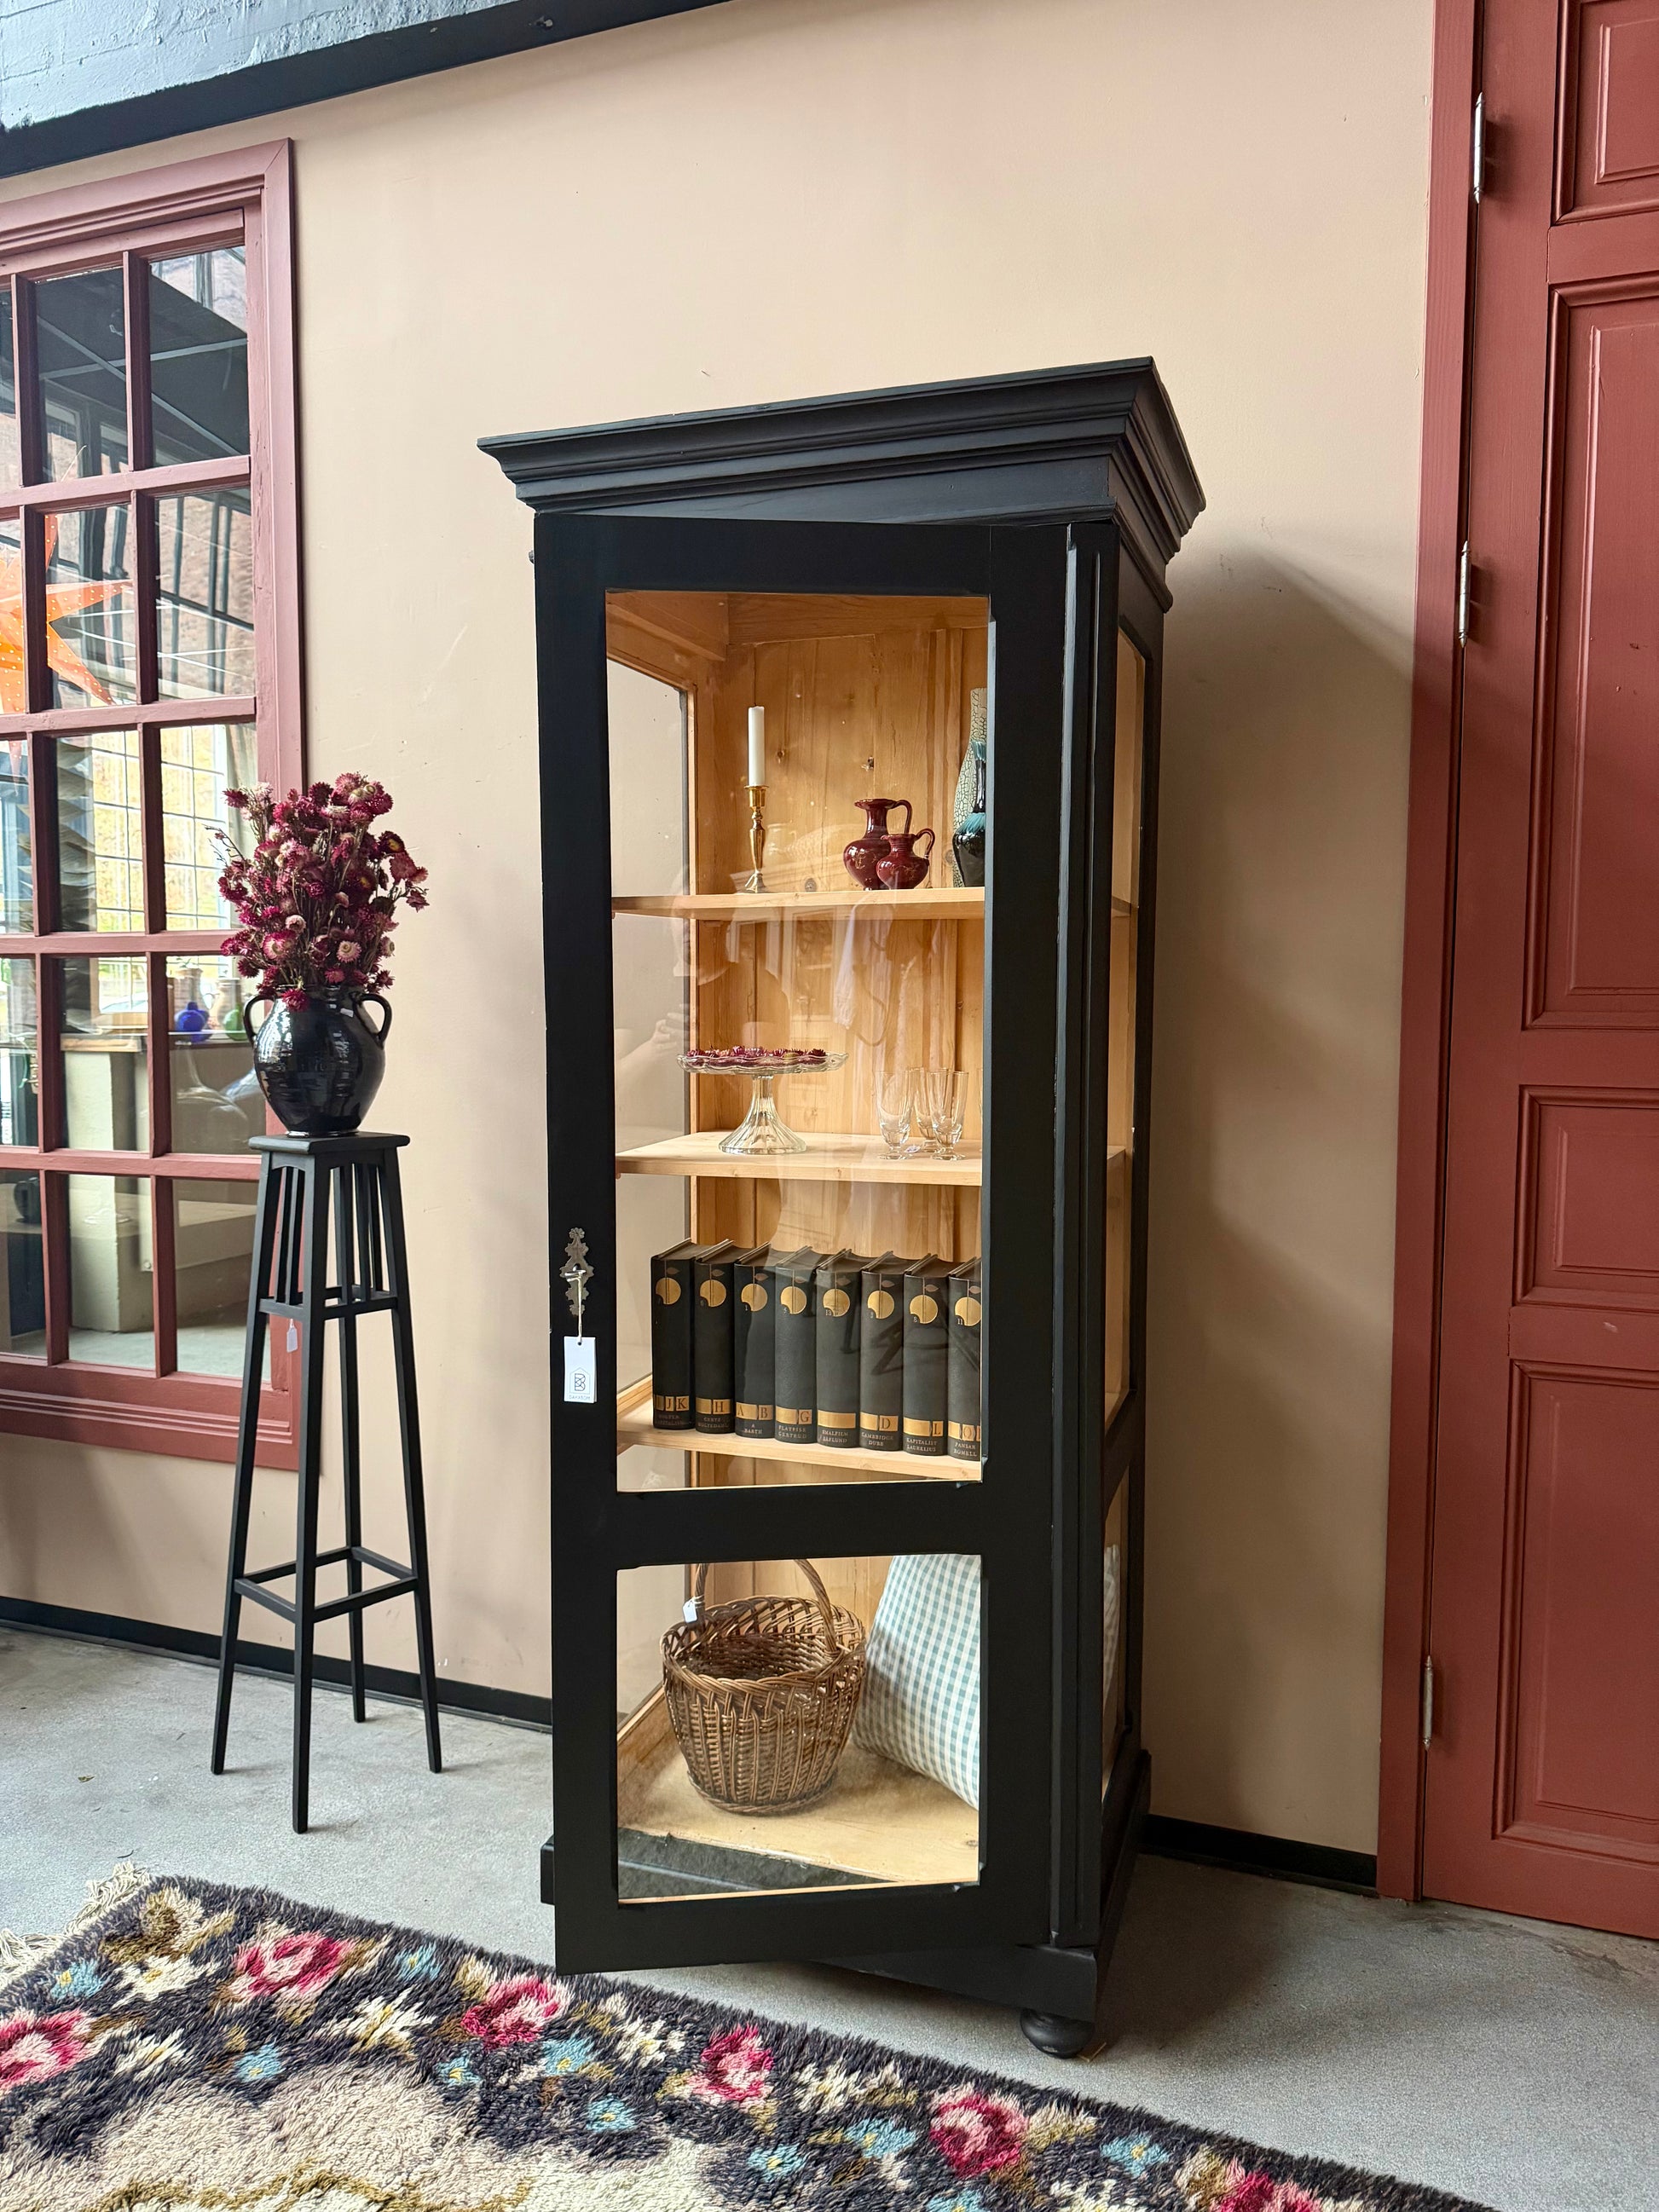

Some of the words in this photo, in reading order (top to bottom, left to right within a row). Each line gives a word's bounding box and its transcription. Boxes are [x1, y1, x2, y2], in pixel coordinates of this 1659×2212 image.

[677, 1398, 687, 1409] K
[714, 1401, 724, 1412] H
[737, 1404, 744, 1416] A
[760, 1406, 768, 1418] B
[800, 1411, 810, 1423] G
[882, 1418, 891, 1429] D
[934, 1423, 941, 1435] L
